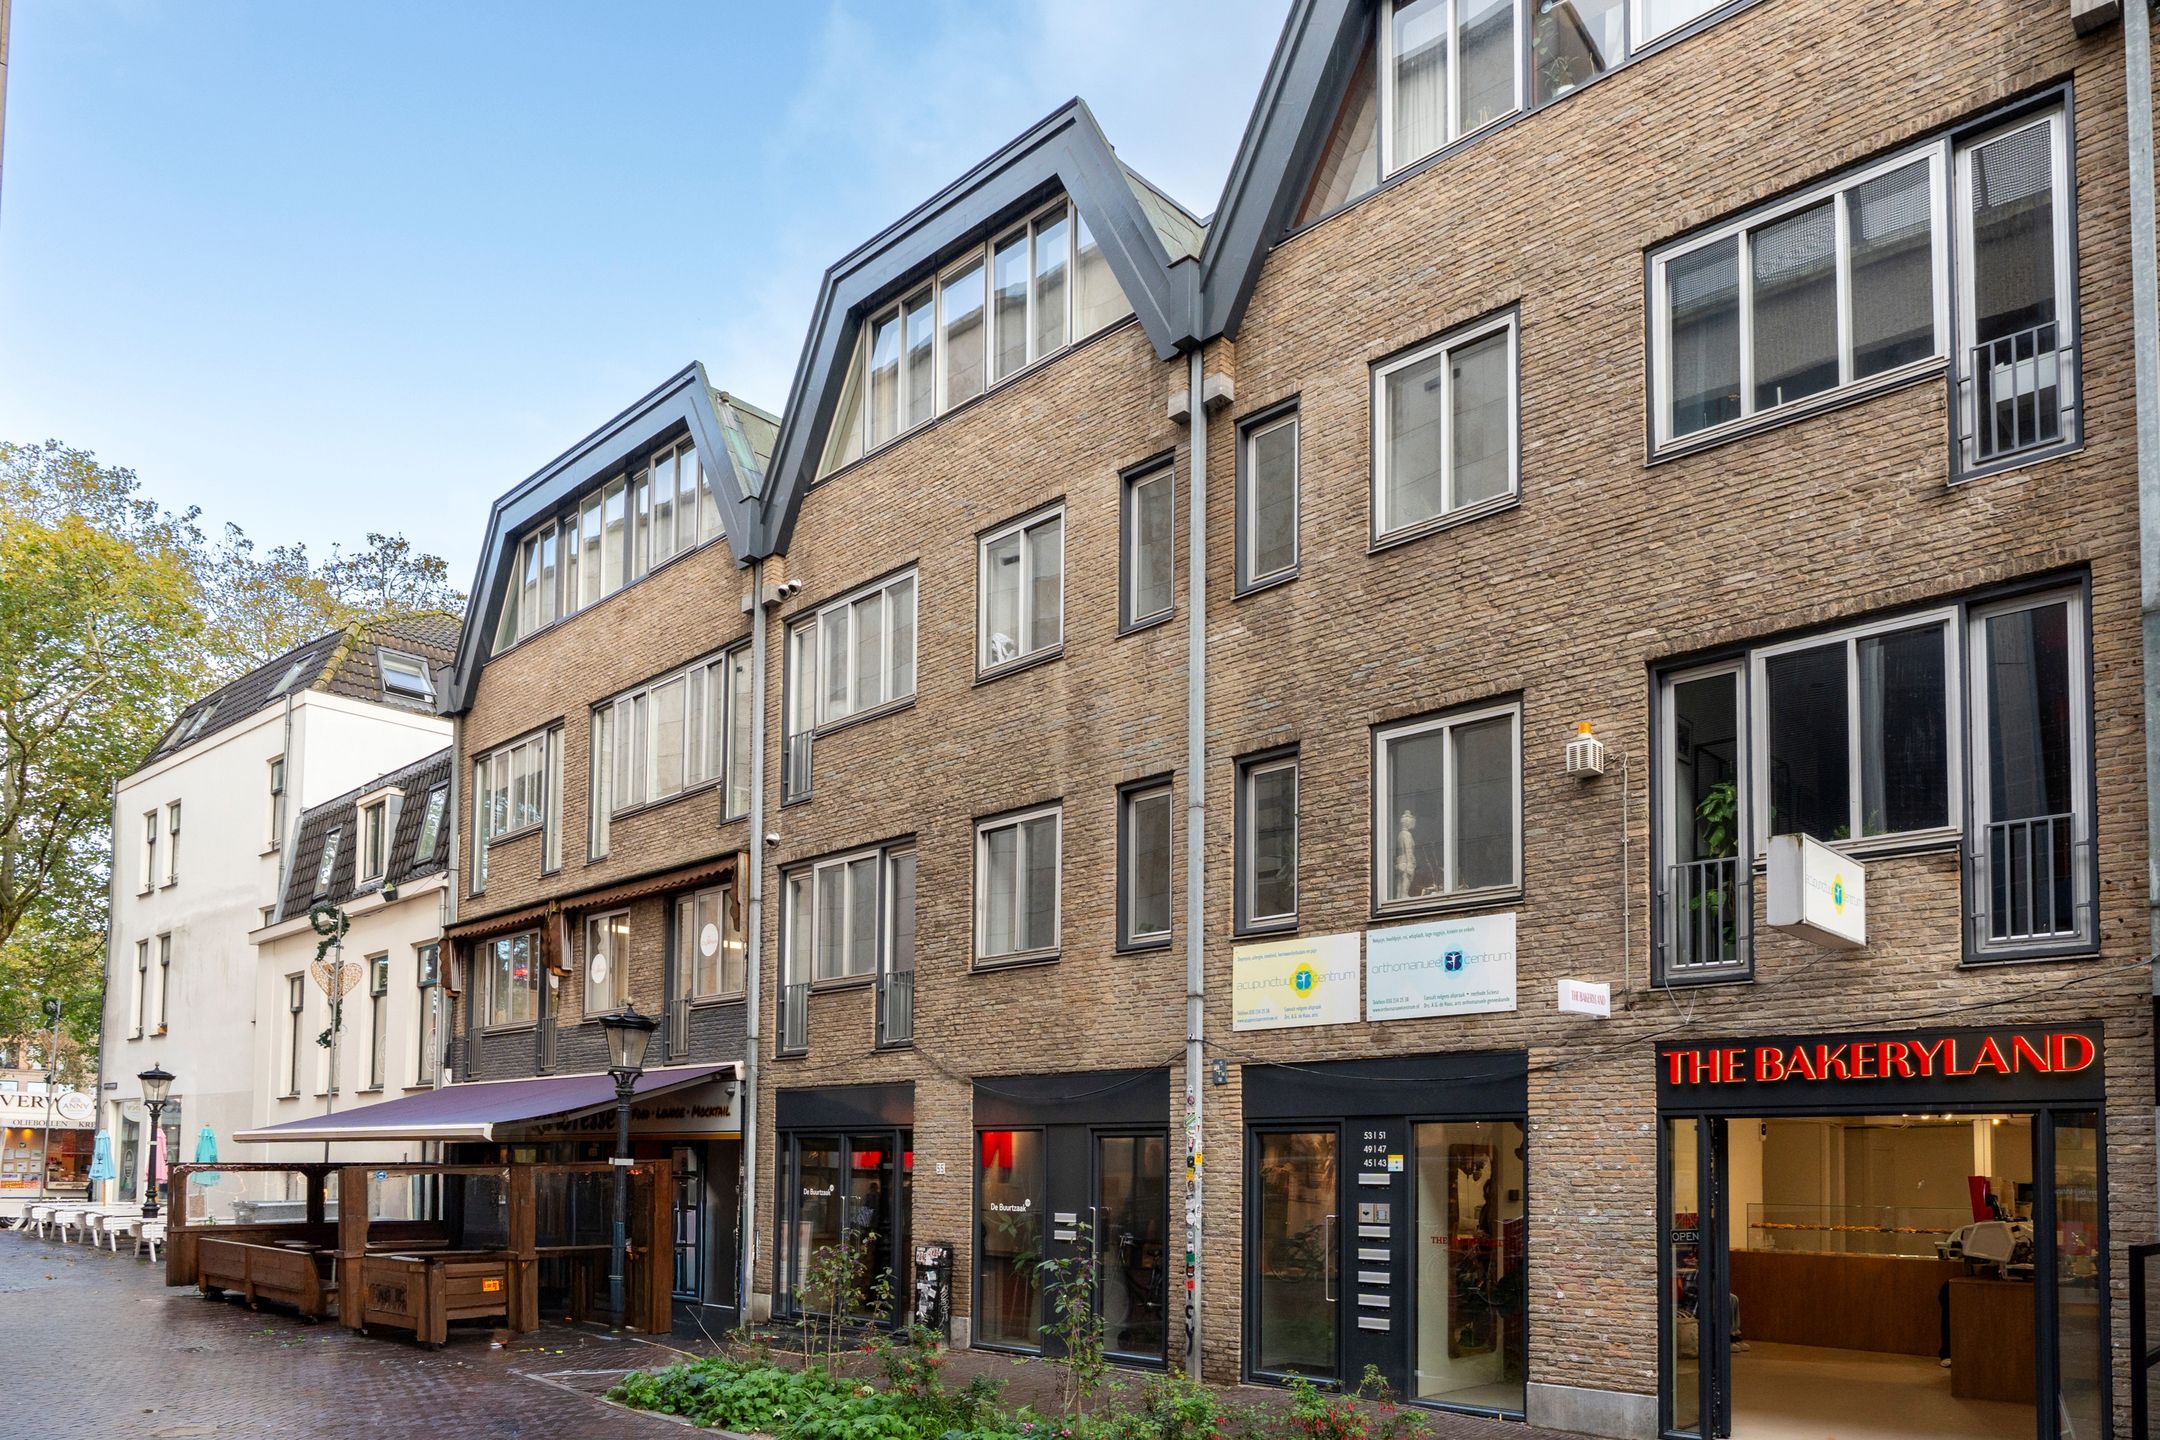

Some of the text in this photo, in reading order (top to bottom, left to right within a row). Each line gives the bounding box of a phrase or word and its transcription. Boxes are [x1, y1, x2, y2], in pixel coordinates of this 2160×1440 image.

[1465, 951, 1512, 965] centrum
[1313, 970, 1356, 984] centrum
[1661, 1033, 2096, 1085] THE BAKERYLAND
[1363, 1131, 1373, 1140] 53
[1378, 1131, 1386, 1140] 51
[1363, 1145, 1373, 1153] 49
[1377, 1145, 1387, 1153] 47
[1363, 1159, 1373, 1167] 45
[1377, 1159, 1387, 1167] 43
[803, 1187, 810, 1196] De
[990, 1202, 1027, 1212] De Buurtzaak
[1430, 1236, 1448, 1245] THE
[1672, 1231, 1700, 1242] OPEN
